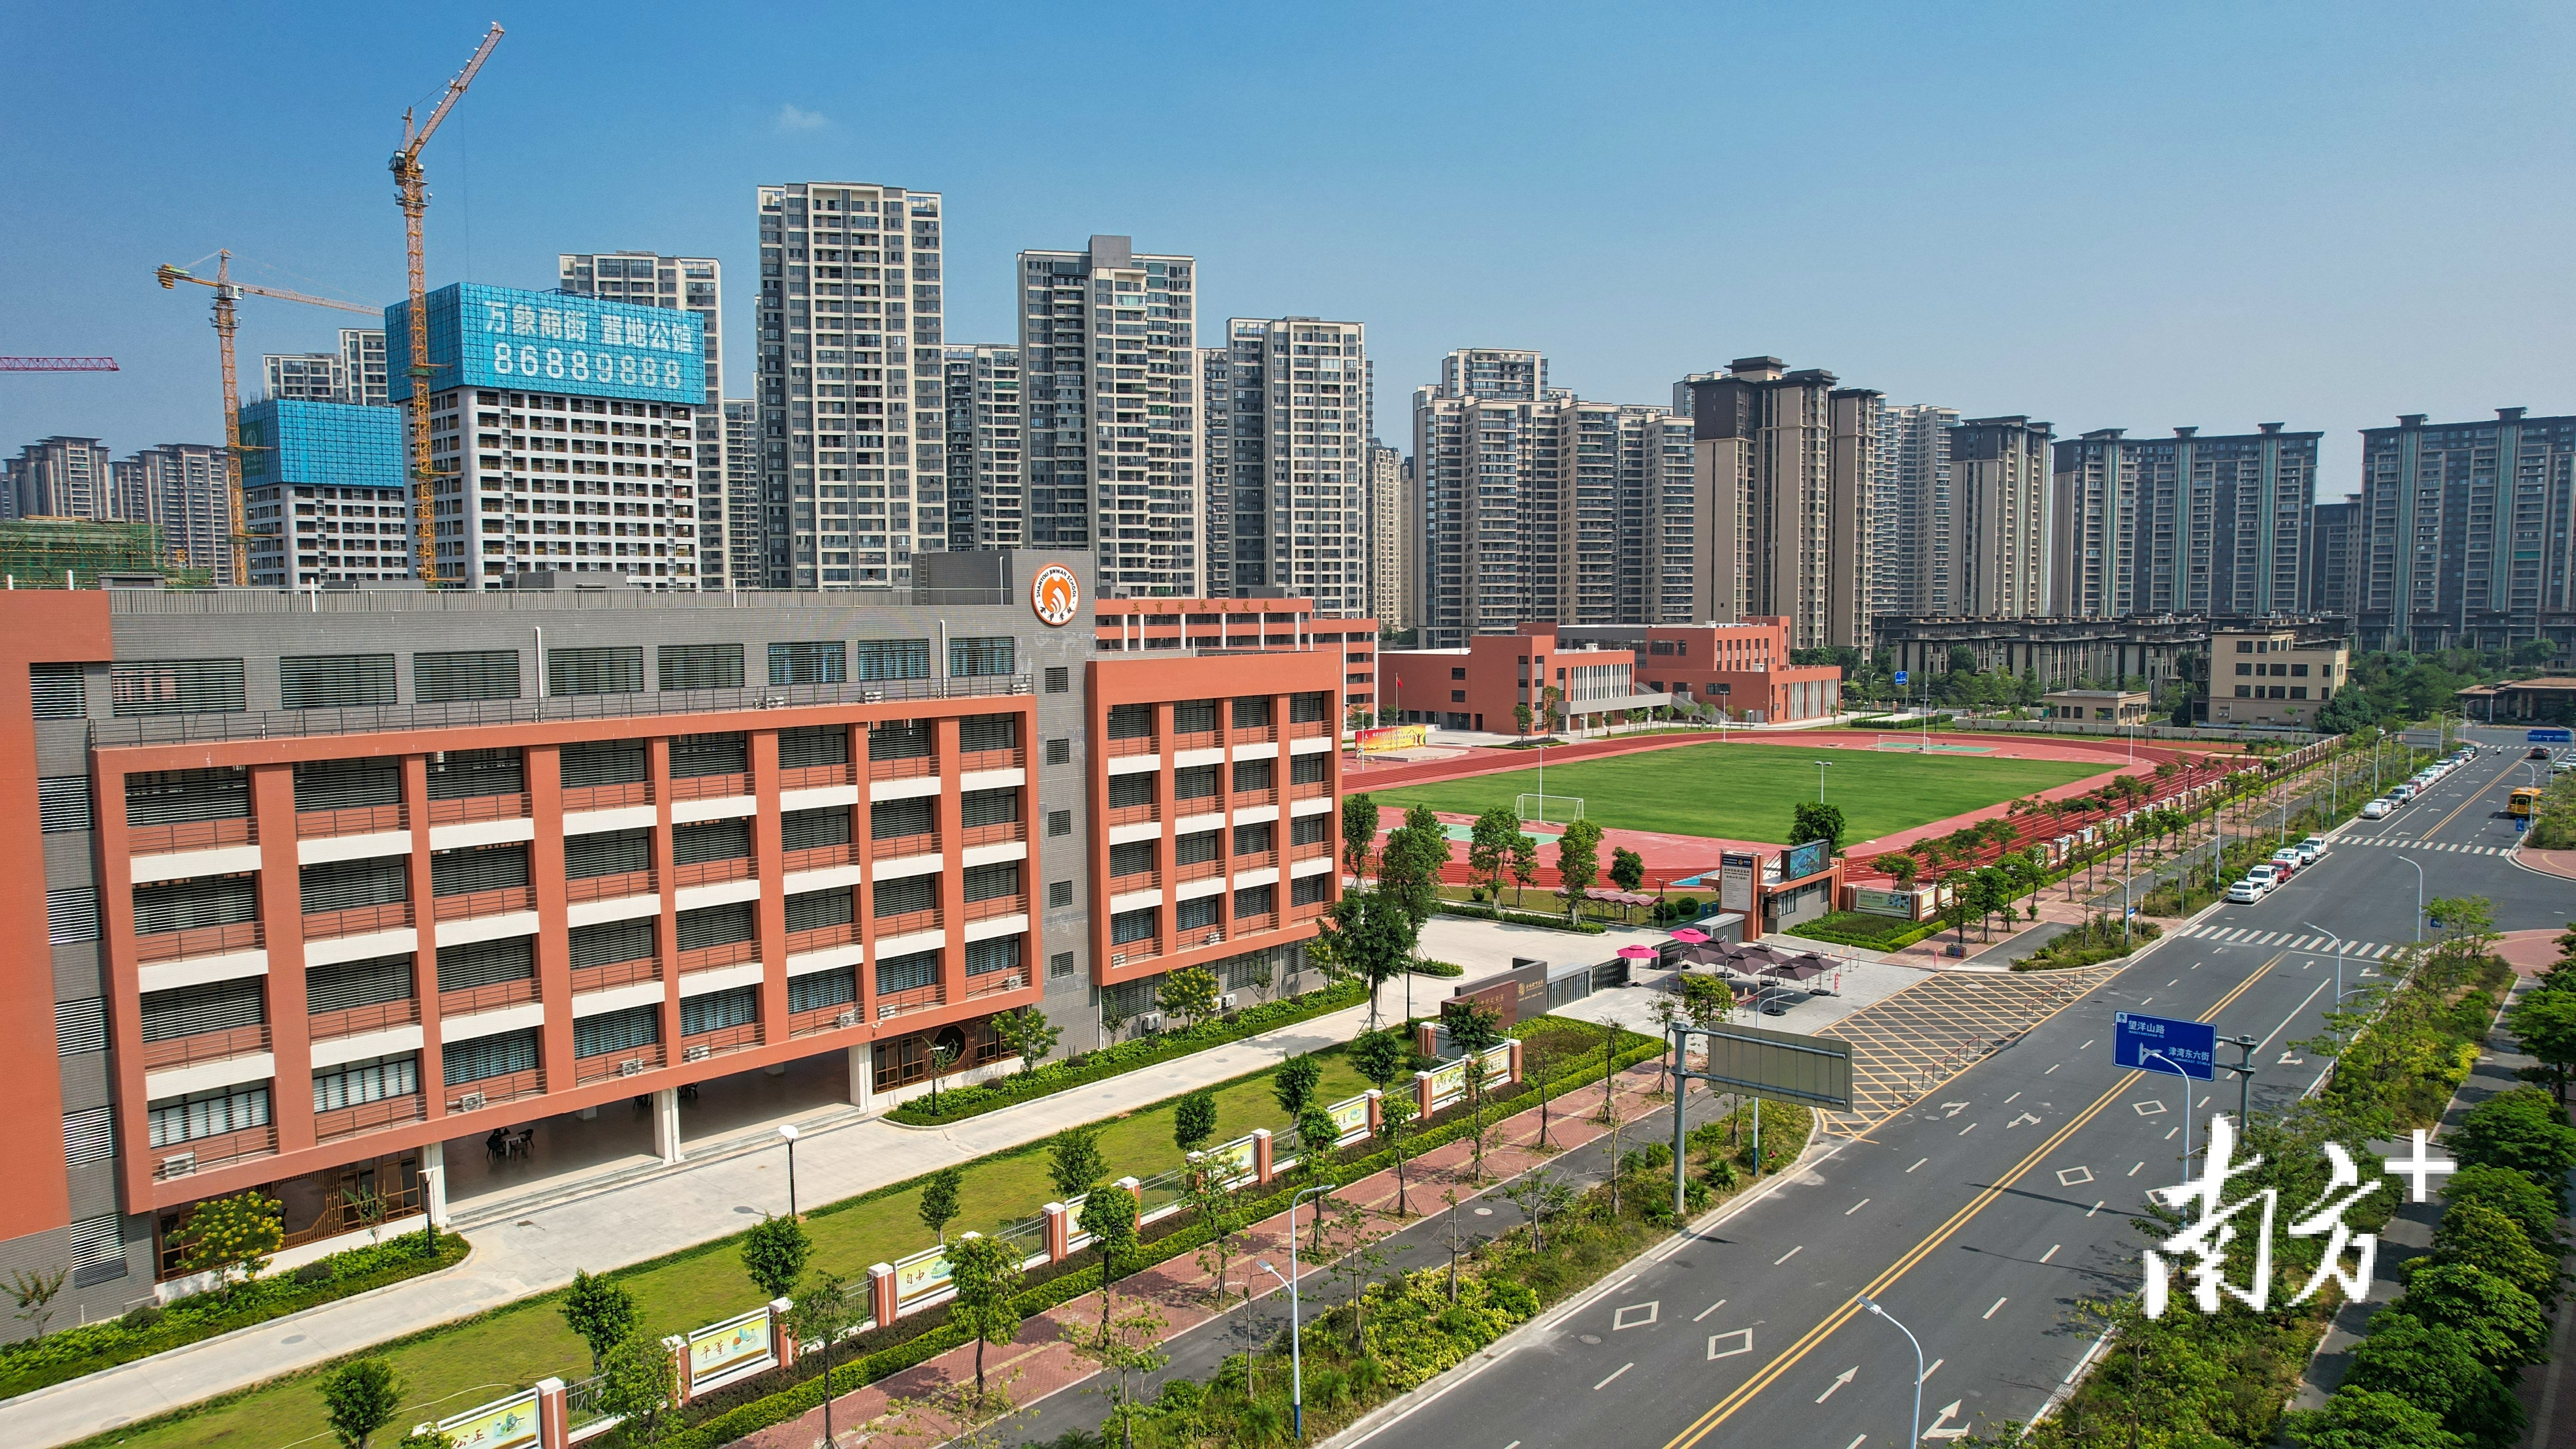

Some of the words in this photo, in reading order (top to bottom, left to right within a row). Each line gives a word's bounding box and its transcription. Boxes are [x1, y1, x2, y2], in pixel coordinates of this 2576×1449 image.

[485, 301, 588, 341] 万象商街
[601, 314, 694, 354] 置地公馆
[493, 342, 681, 389] 86889888
[1037, 572, 1049, 597] SHANTOU
[1067, 575, 1077, 597] SCHOOL
[2128, 1020, 2165, 1034] 望洋山路
[2168, 1046, 2210, 1062] 津湾东六街
[906, 1269, 925, 1285] 自由
[700, 1338, 724, 1360] 平等
[451, 1429, 485, 1448] 公正
